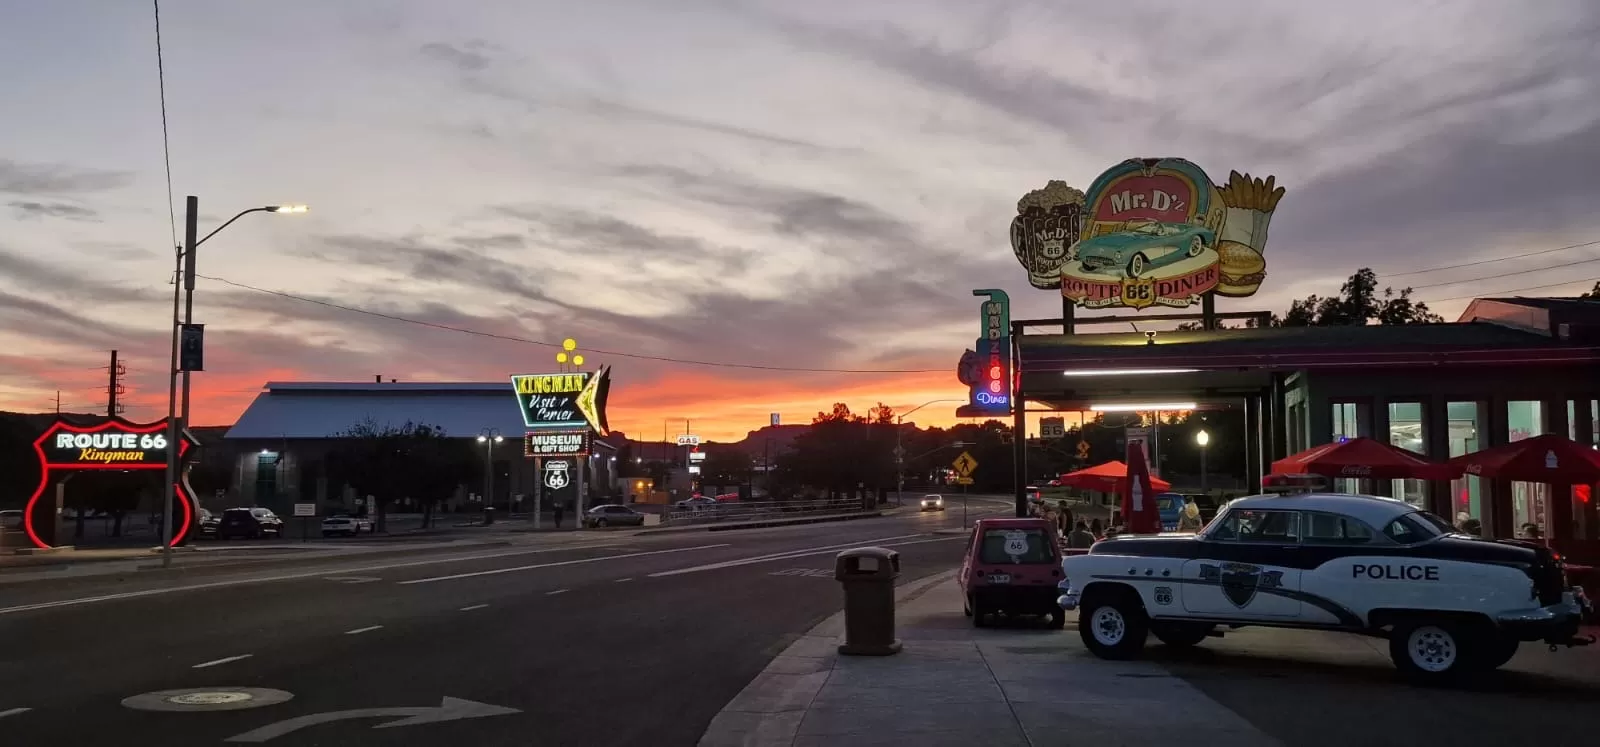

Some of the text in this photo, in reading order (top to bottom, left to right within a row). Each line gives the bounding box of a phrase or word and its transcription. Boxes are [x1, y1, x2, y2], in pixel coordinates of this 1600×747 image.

[1110, 190, 1148, 214] Mr.
[1047, 247, 1060, 255] 66
[1063, 268, 1214, 299] ROUTE 66 DINER
[517, 375, 583, 394] KINGMAN
[529, 394, 569, 409] Visitor
[976, 392, 1008, 405] Diner
[536, 407, 575, 421] Center
[1041, 425, 1062, 436] 66
[56, 433, 167, 449] ROUTE 66
[532, 435, 582, 445] MUSEUM
[558, 444, 580, 452] SHOP
[78, 447, 144, 464] Kingman
[549, 475, 564, 486] 66
[1010, 541, 1023, 550] 66
[1352, 564, 1440, 581] POLICE
[1156, 593, 1170, 603] 66
